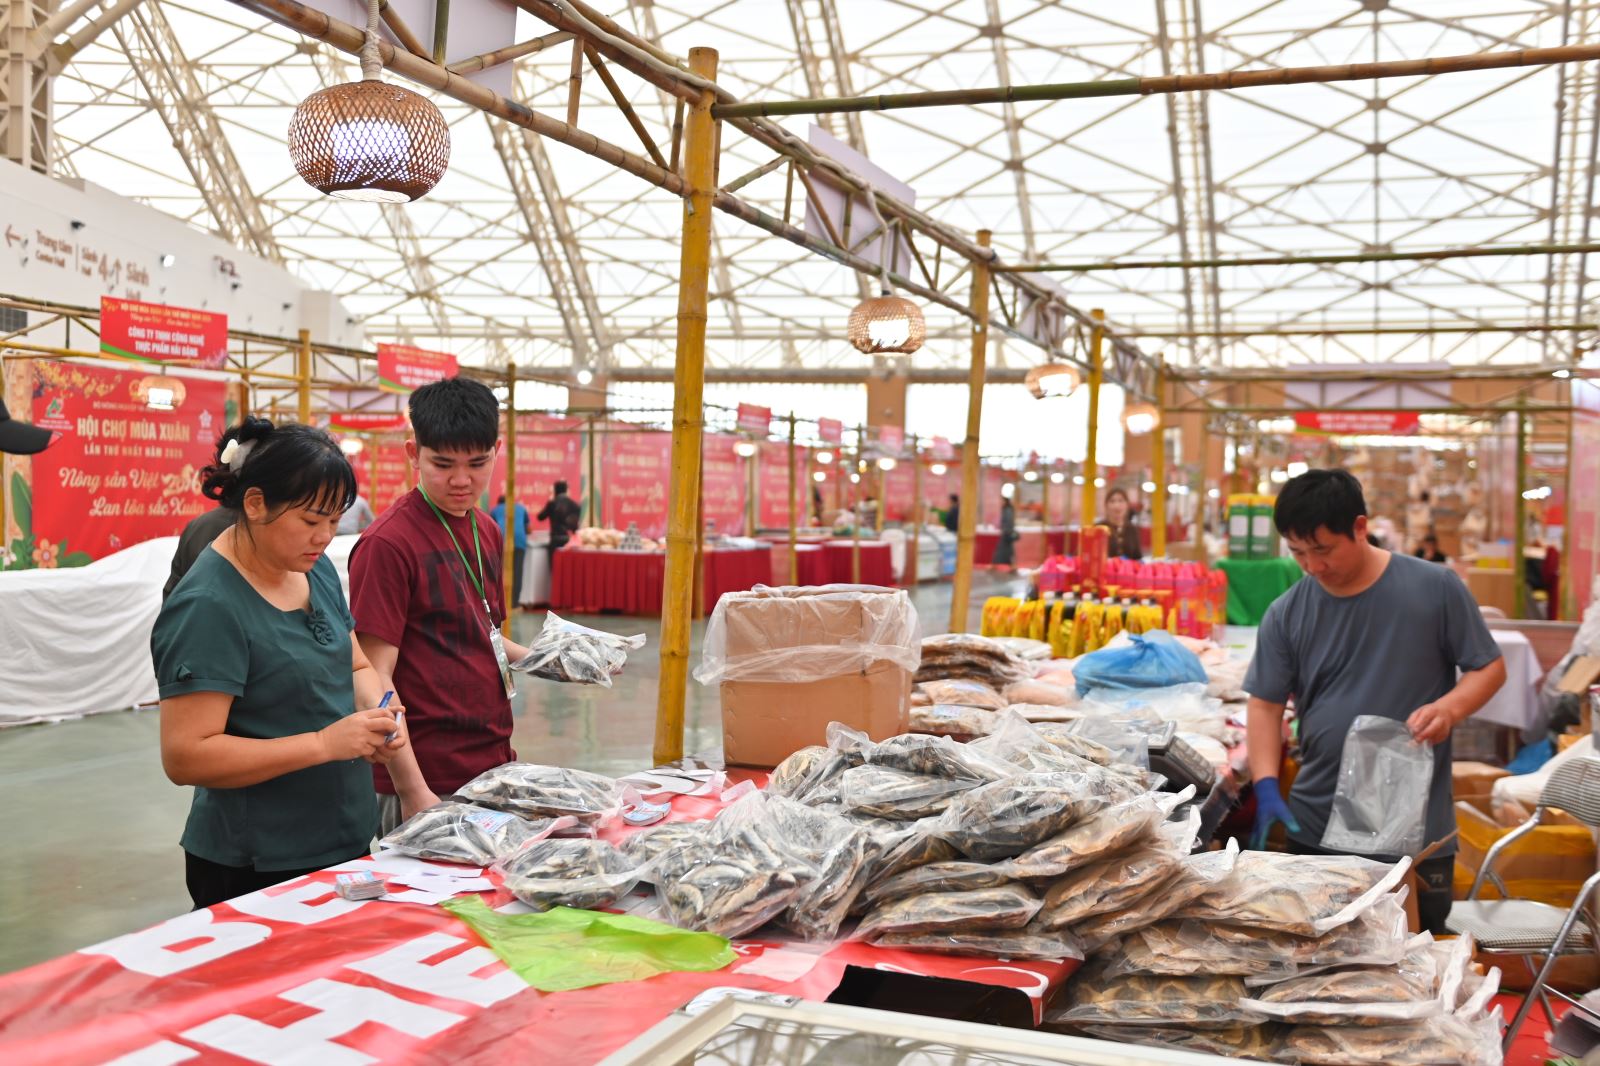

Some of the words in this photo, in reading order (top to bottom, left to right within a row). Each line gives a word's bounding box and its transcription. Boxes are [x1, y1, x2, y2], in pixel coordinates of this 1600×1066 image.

[128, 325, 145, 339] CÔNG
[146, 329, 154, 340] TY
[77, 414, 99, 441] HỘI
[101, 418, 128, 443] CHỢ
[130, 418, 157, 440] MÙA
[159, 421, 190, 443] XUÂN
[84, 442, 100, 457] LẦN
[59, 467, 100, 494] Nông
[104, 471, 128, 489] sản
[129, 468, 160, 492] Việt
[89, 496, 121, 516] Lan
